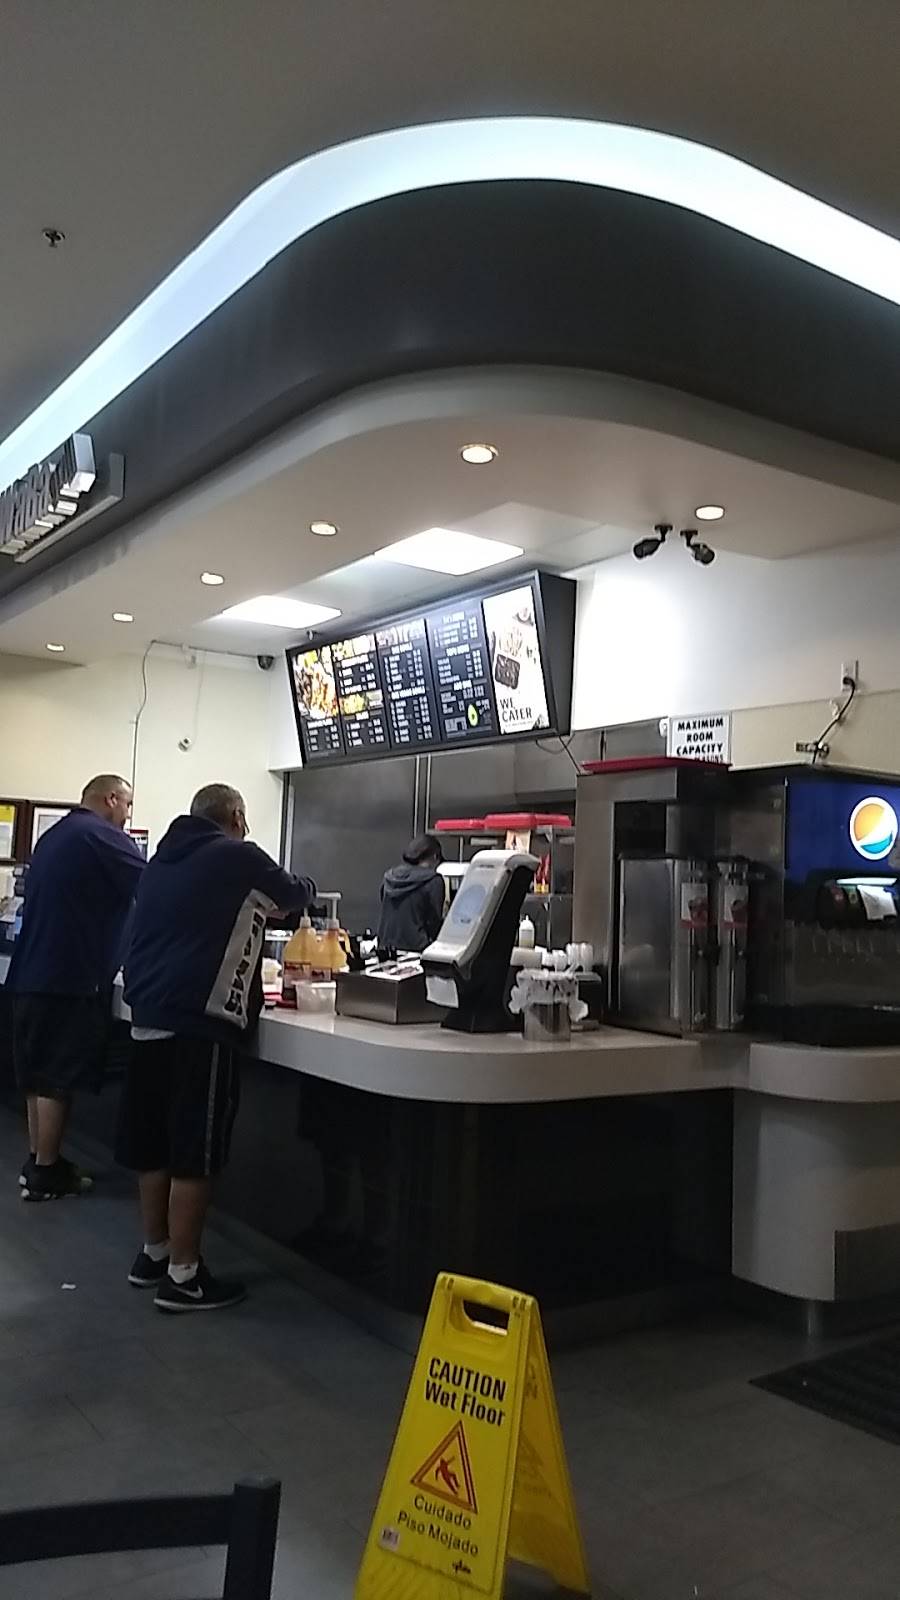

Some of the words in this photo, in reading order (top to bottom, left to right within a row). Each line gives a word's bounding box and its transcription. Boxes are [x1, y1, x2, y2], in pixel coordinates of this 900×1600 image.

[499, 697, 516, 710] WE
[501, 706, 532, 722] CATER
[677, 717, 724, 731] MAXIMUM
[686, 731, 713, 743] ROOM
[676, 743, 723, 756] CAPACITY
[429, 1357, 506, 1402] CAUTION
[425, 1379, 457, 1411] Wet
[461, 1392, 506, 1427] Floor
[414, 1494, 471, 1529] Cuidado
[397, 1510, 425, 1535] Piso
[427, 1523, 478, 1557] Mojado
